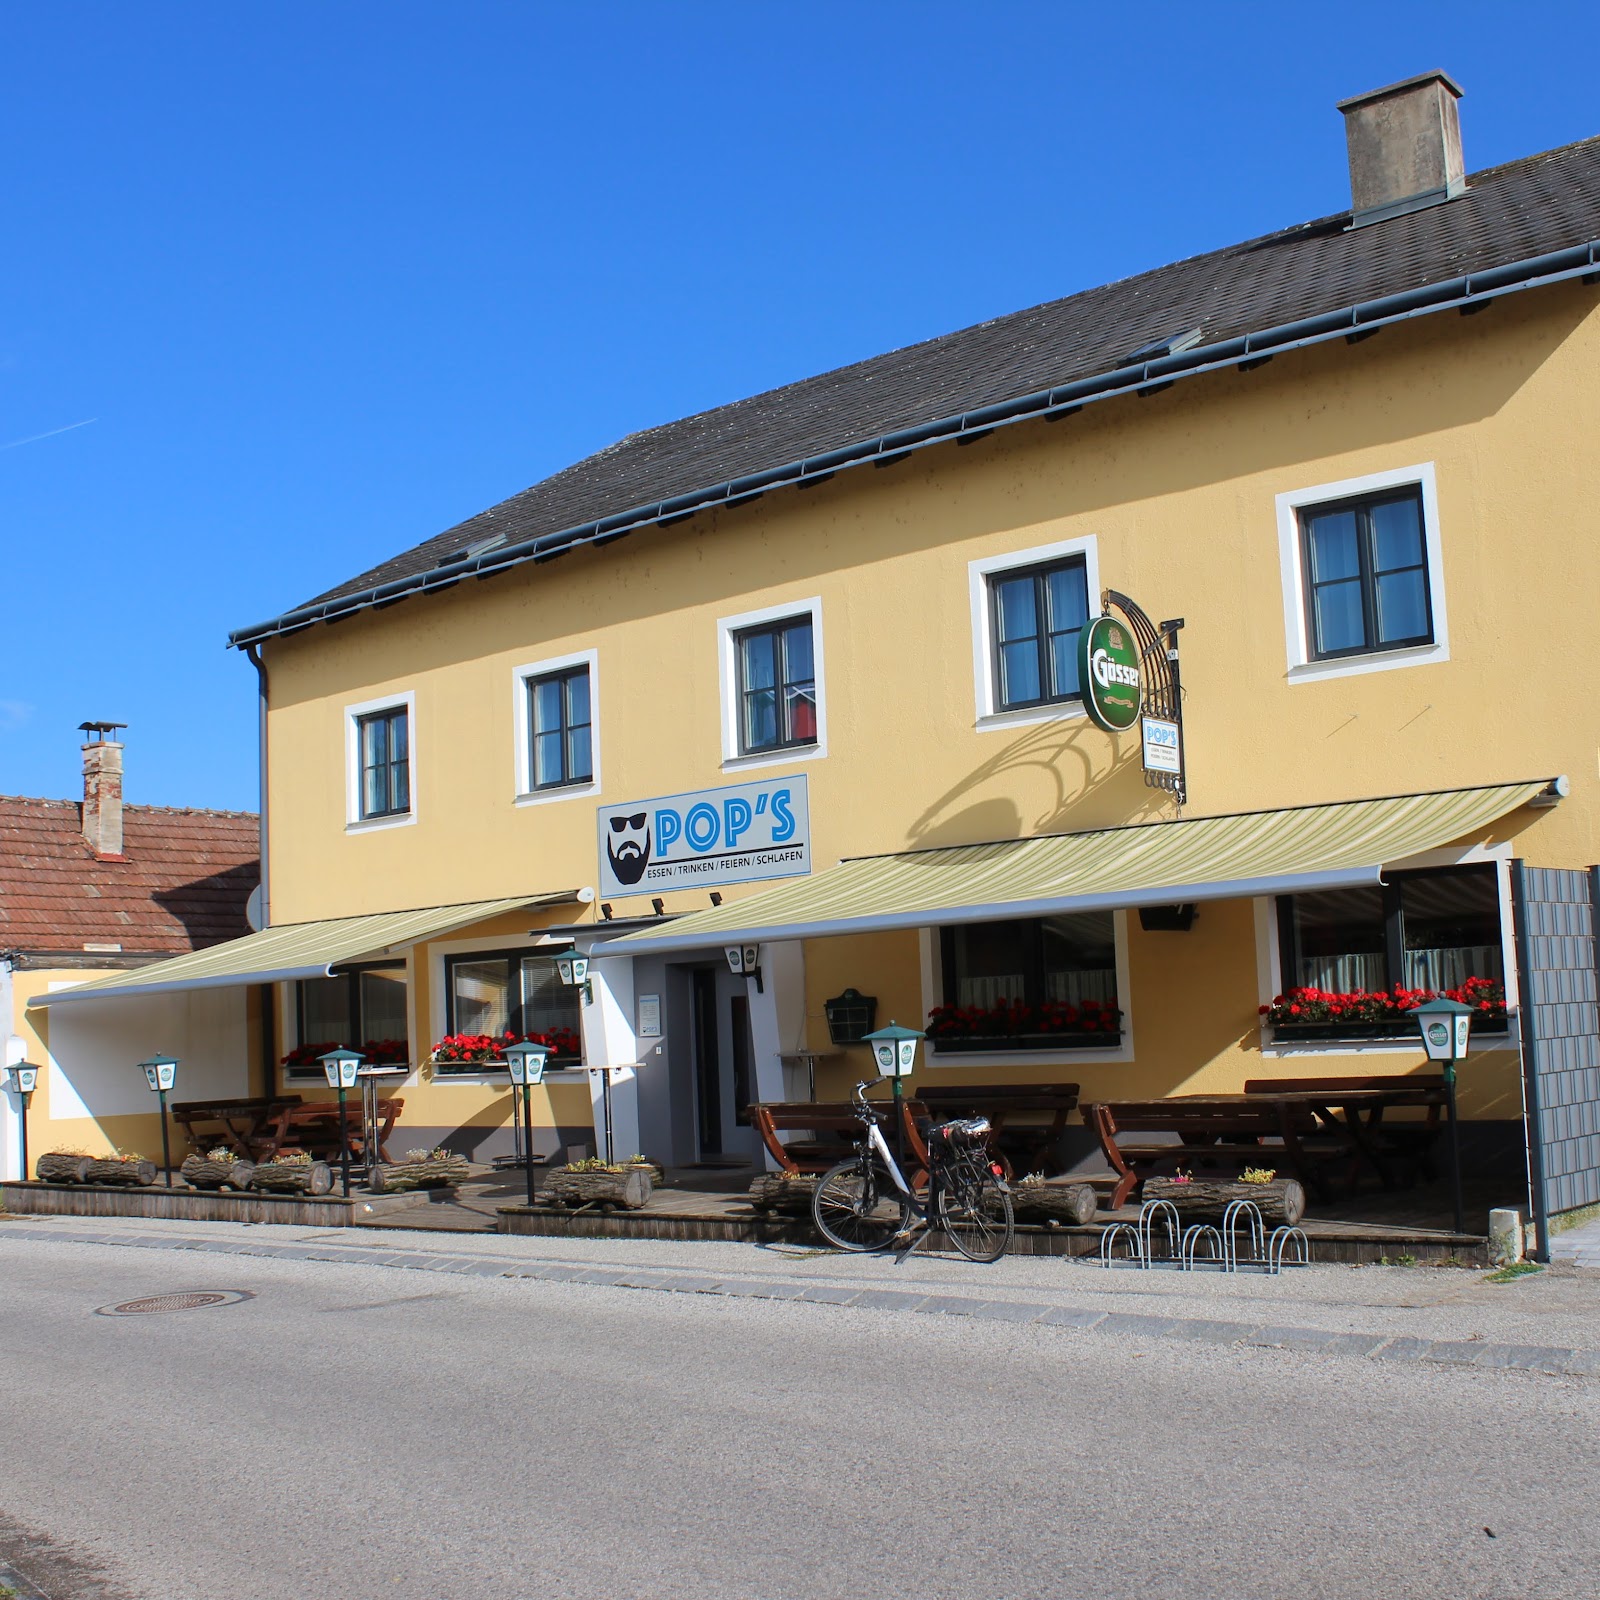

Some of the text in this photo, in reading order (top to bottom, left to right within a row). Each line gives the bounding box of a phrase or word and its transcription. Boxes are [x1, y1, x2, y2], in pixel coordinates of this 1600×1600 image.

[1093, 648, 1139, 688] Gösser
[1147, 726, 1176, 746] POP'S
[655, 789, 796, 857] POP'S
[647, 867, 673, 879] ESSEN
[678, 861, 714, 875] TRINKEN
[720, 857, 750, 870] FEIERN
[756, 850, 803, 865] SCHLAFEN
